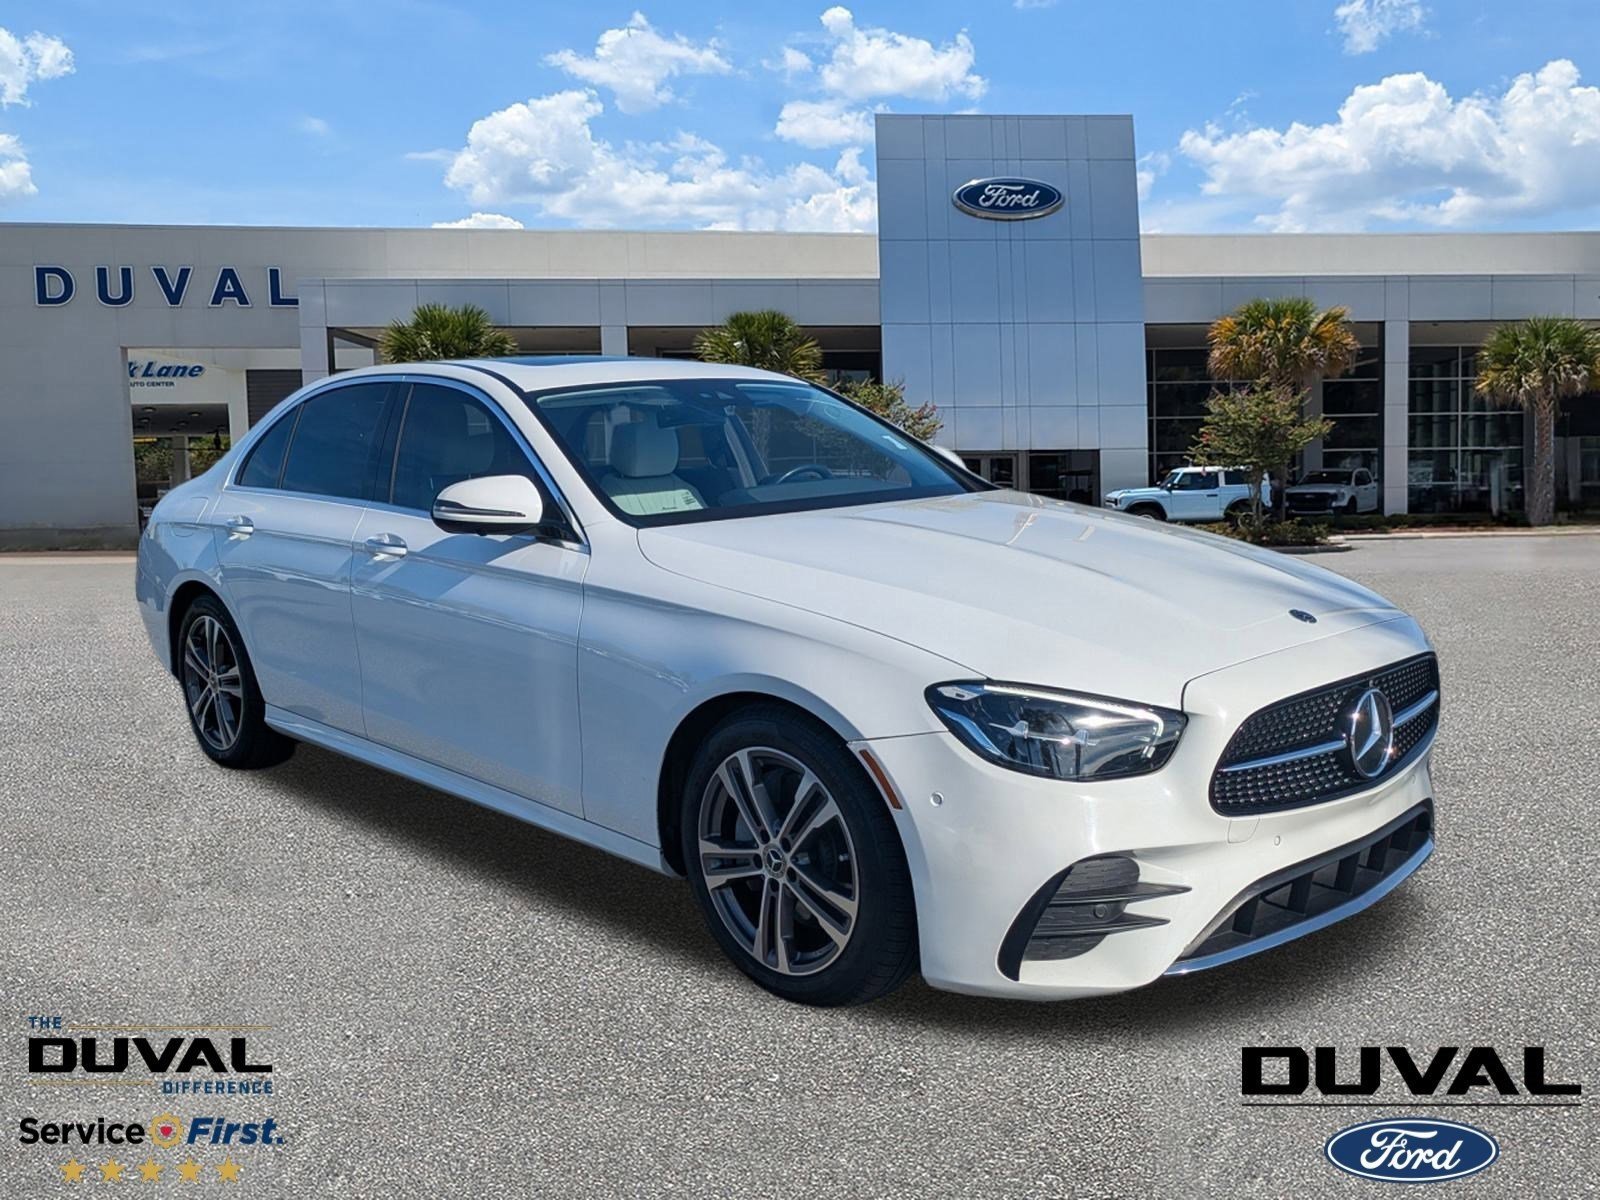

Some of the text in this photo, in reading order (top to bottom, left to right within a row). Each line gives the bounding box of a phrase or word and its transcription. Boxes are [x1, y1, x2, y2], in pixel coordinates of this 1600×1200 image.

[978, 184, 1041, 208] Ford
[33, 265, 298, 307] DUVAL
[141, 361, 205, 378] Lane
